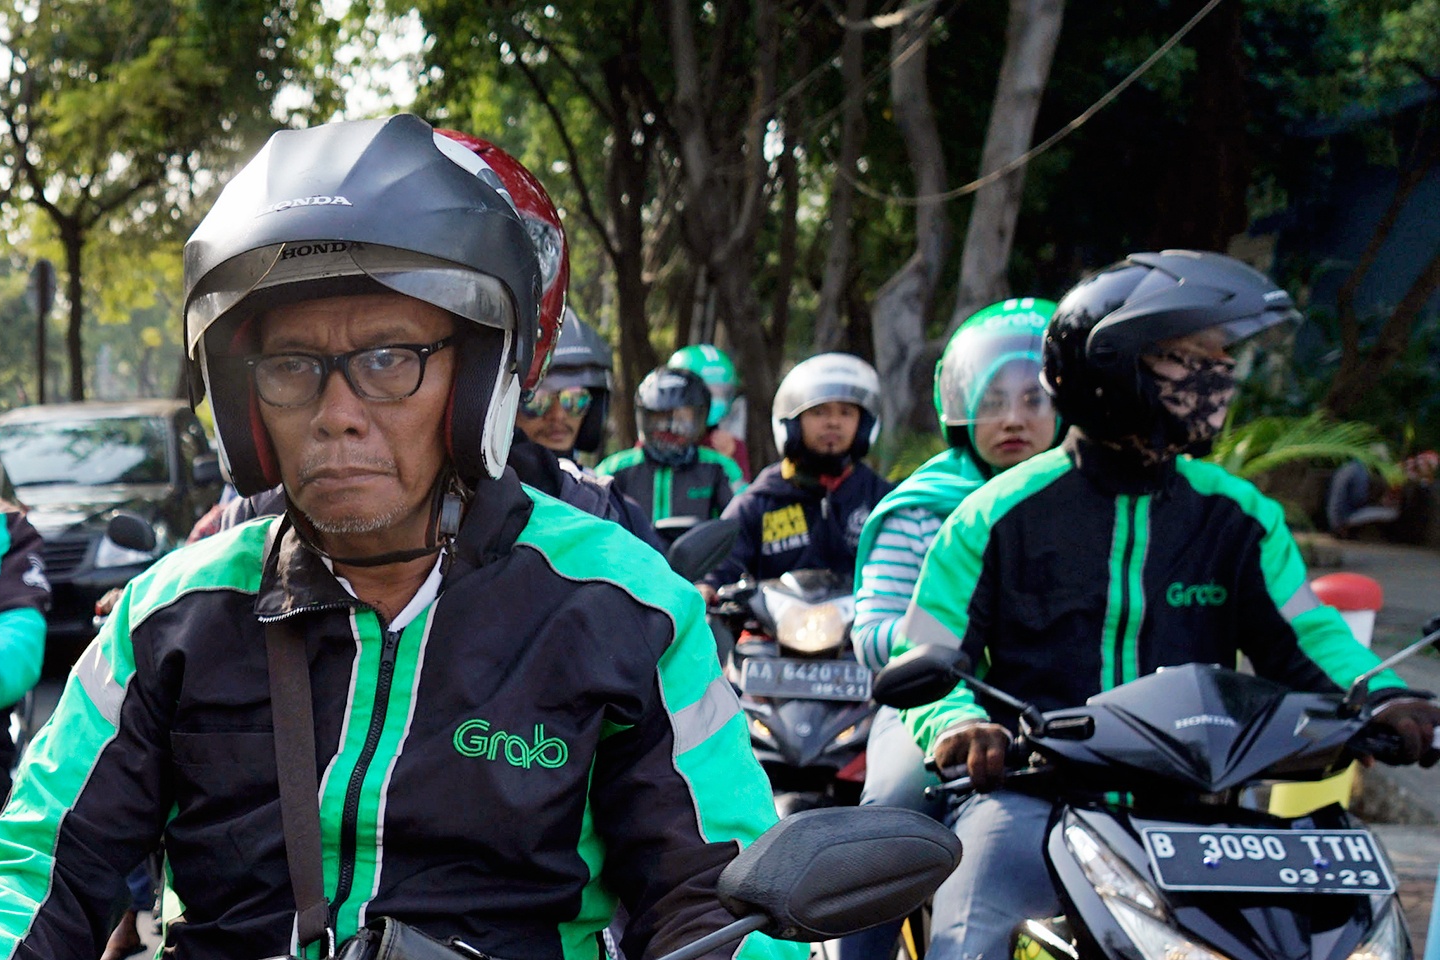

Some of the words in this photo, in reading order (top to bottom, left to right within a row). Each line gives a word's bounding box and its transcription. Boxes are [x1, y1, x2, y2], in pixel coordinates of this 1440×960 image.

[1166, 580, 1228, 607] Grab
[1175, 713, 1238, 731] HONDA
[452, 718, 569, 769] Grab
[1150, 832, 1176, 858] B
[1198, 834, 1287, 860] 3090
[1300, 835, 1374, 862] TTH
